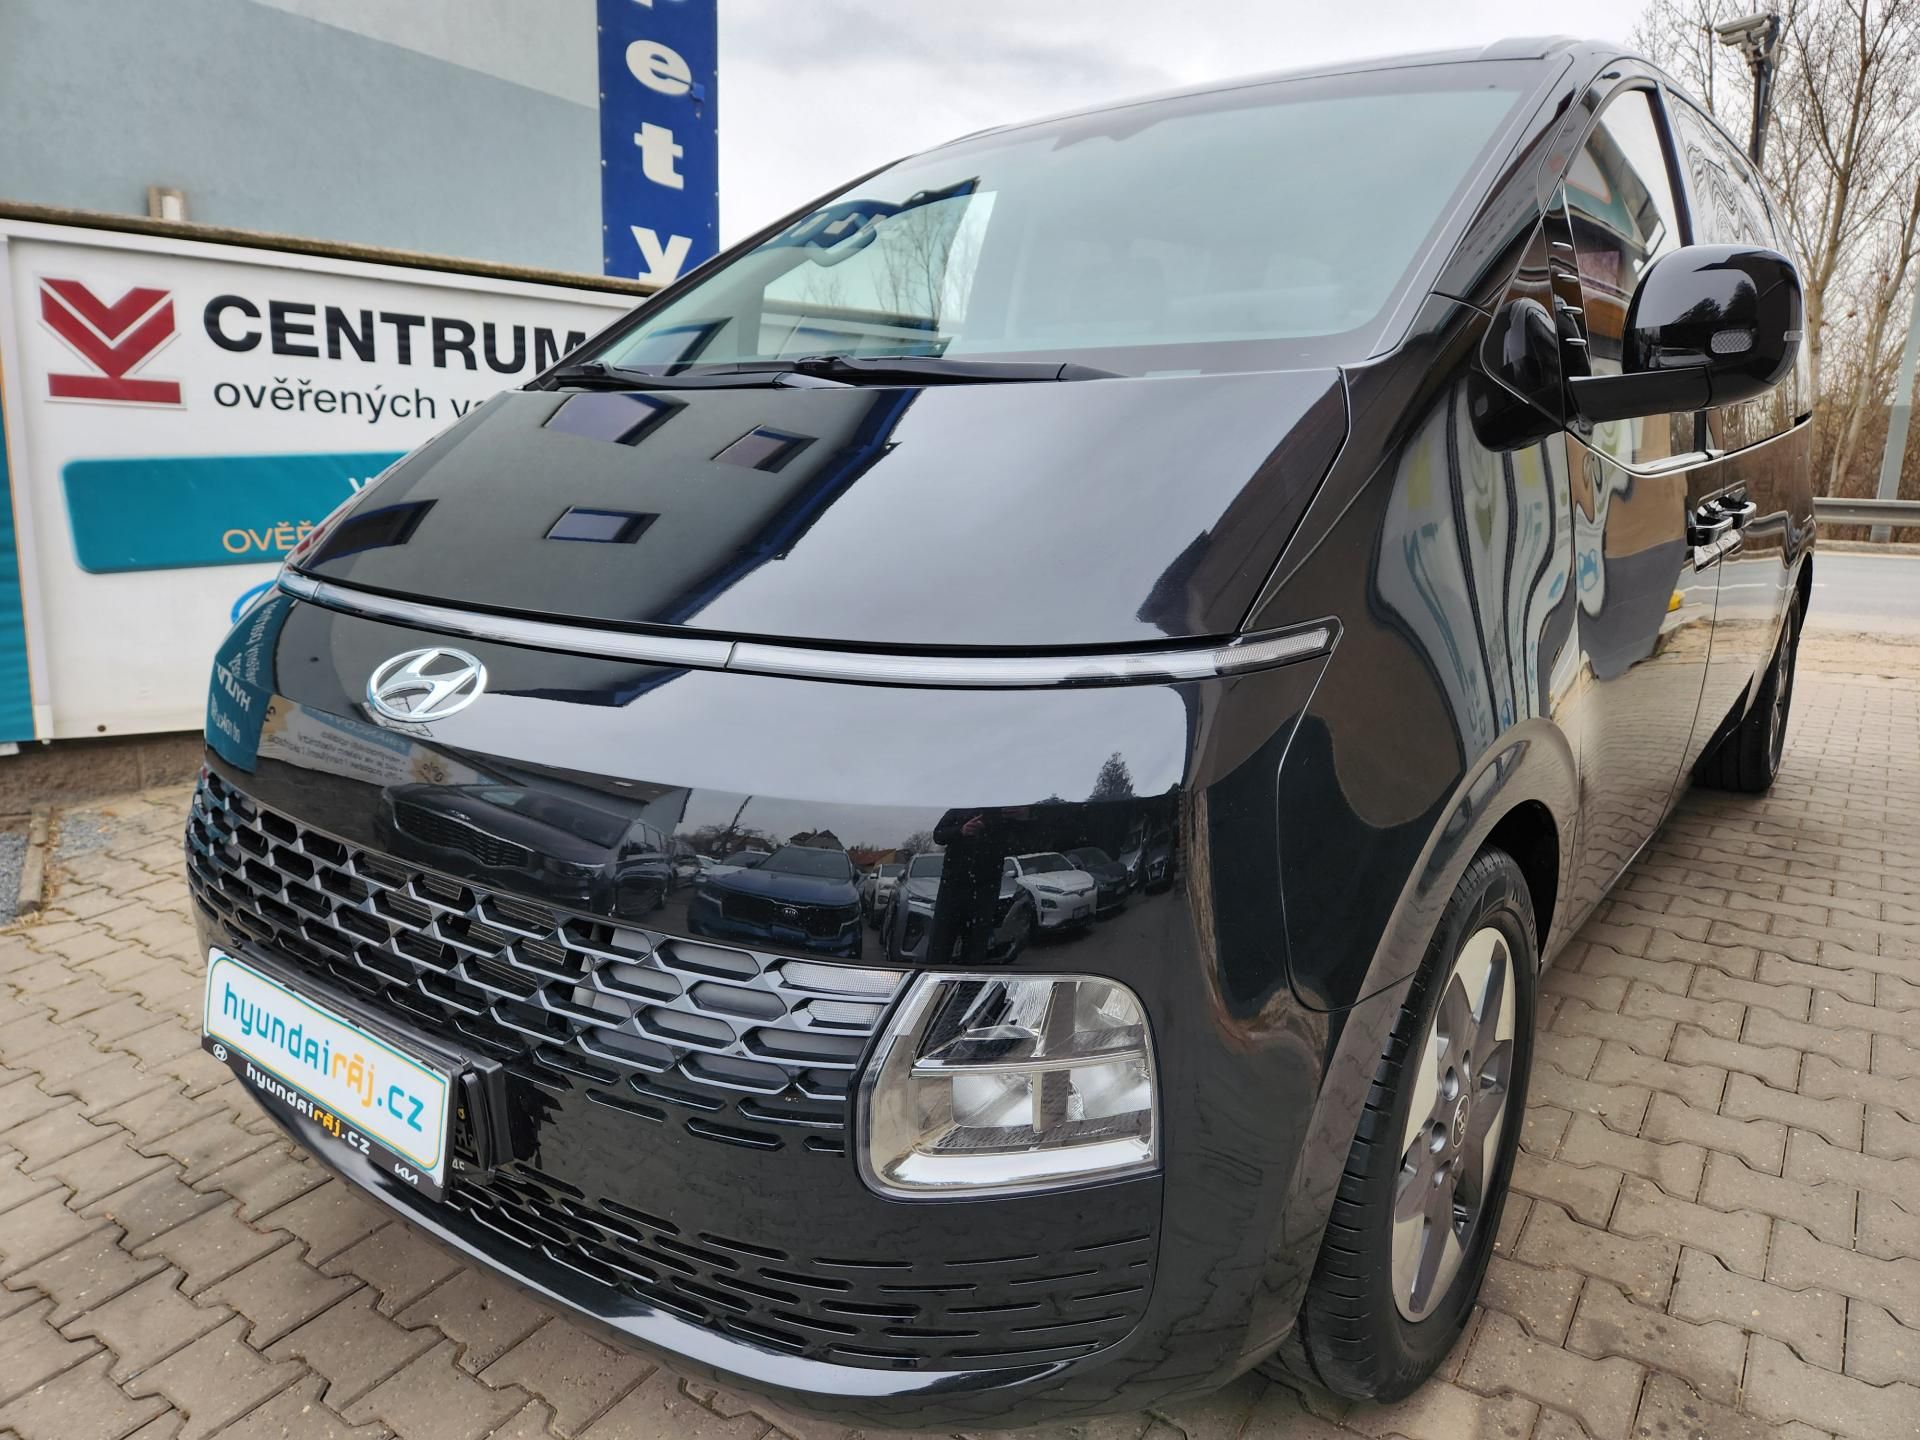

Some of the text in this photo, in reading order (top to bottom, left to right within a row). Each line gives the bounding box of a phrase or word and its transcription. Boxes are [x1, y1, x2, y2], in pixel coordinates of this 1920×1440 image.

[626, 0, 693, 281] ety
[203, 294, 586, 375] CENTRUM
[214, 376, 436, 424] ověřených
